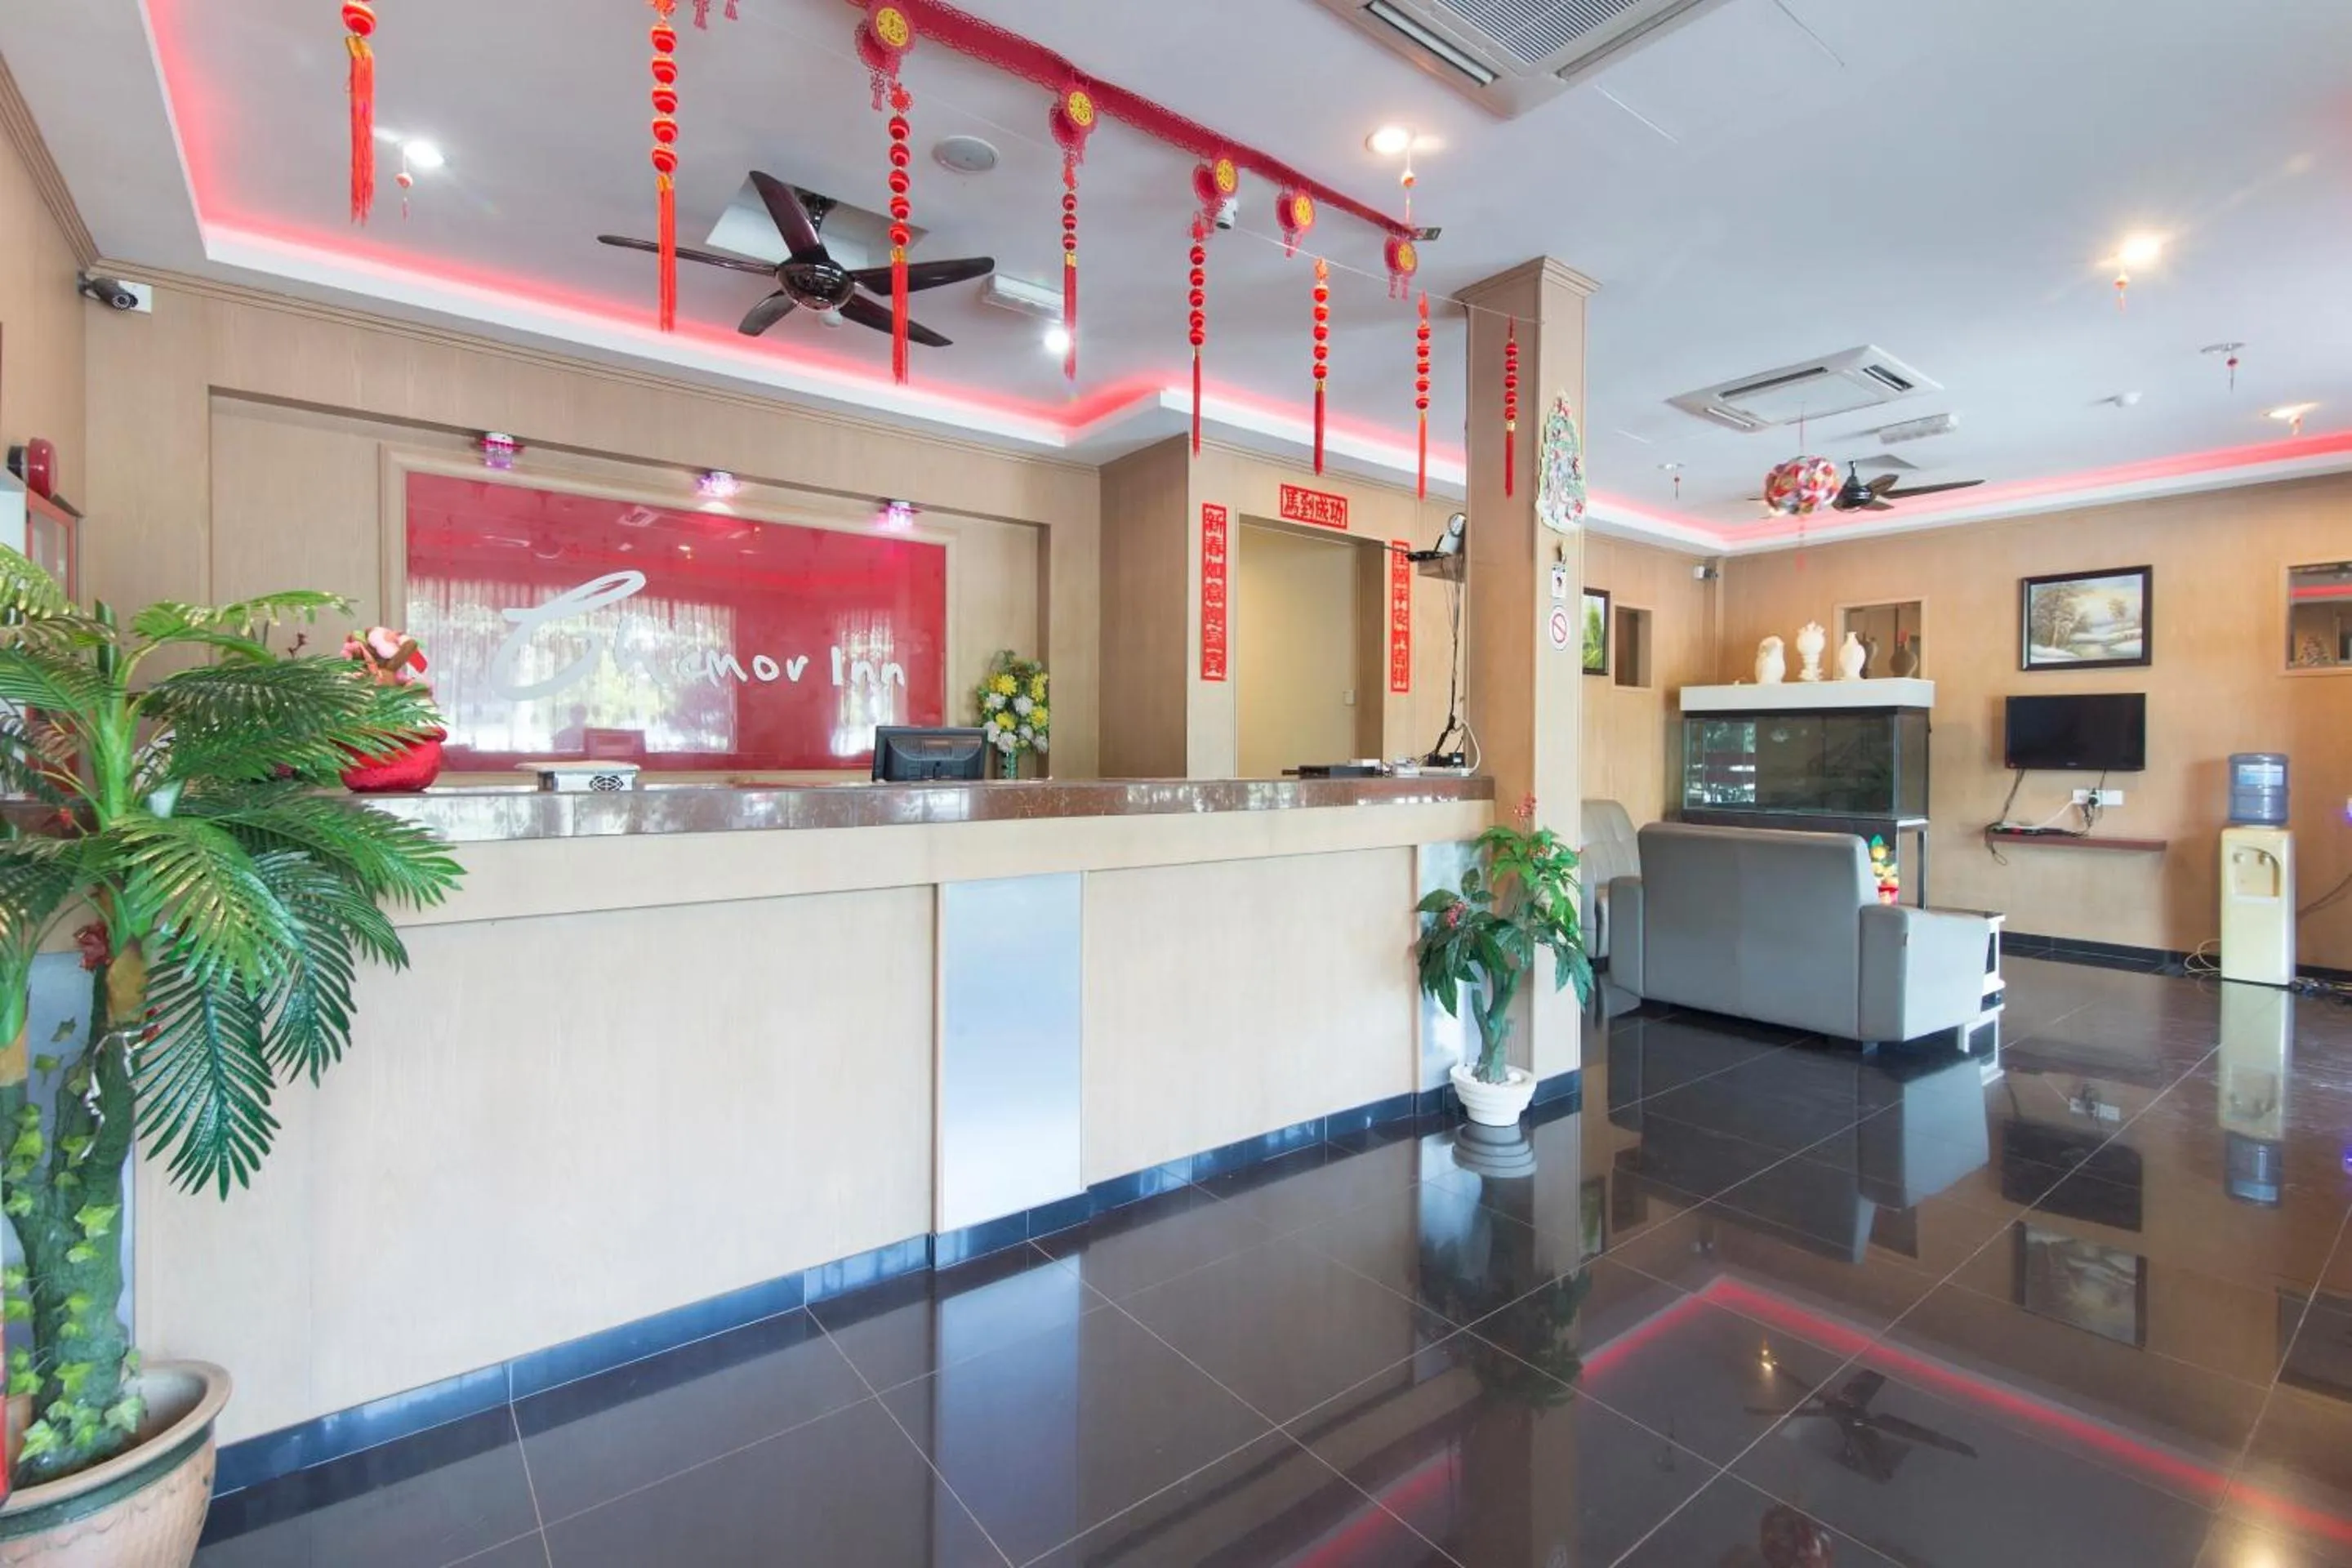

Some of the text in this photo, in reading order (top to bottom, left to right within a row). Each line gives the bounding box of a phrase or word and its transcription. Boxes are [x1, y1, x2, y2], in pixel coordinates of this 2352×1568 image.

[1284, 488, 1343, 523] 馬到成功
[831, 646, 905, 686] Inn
